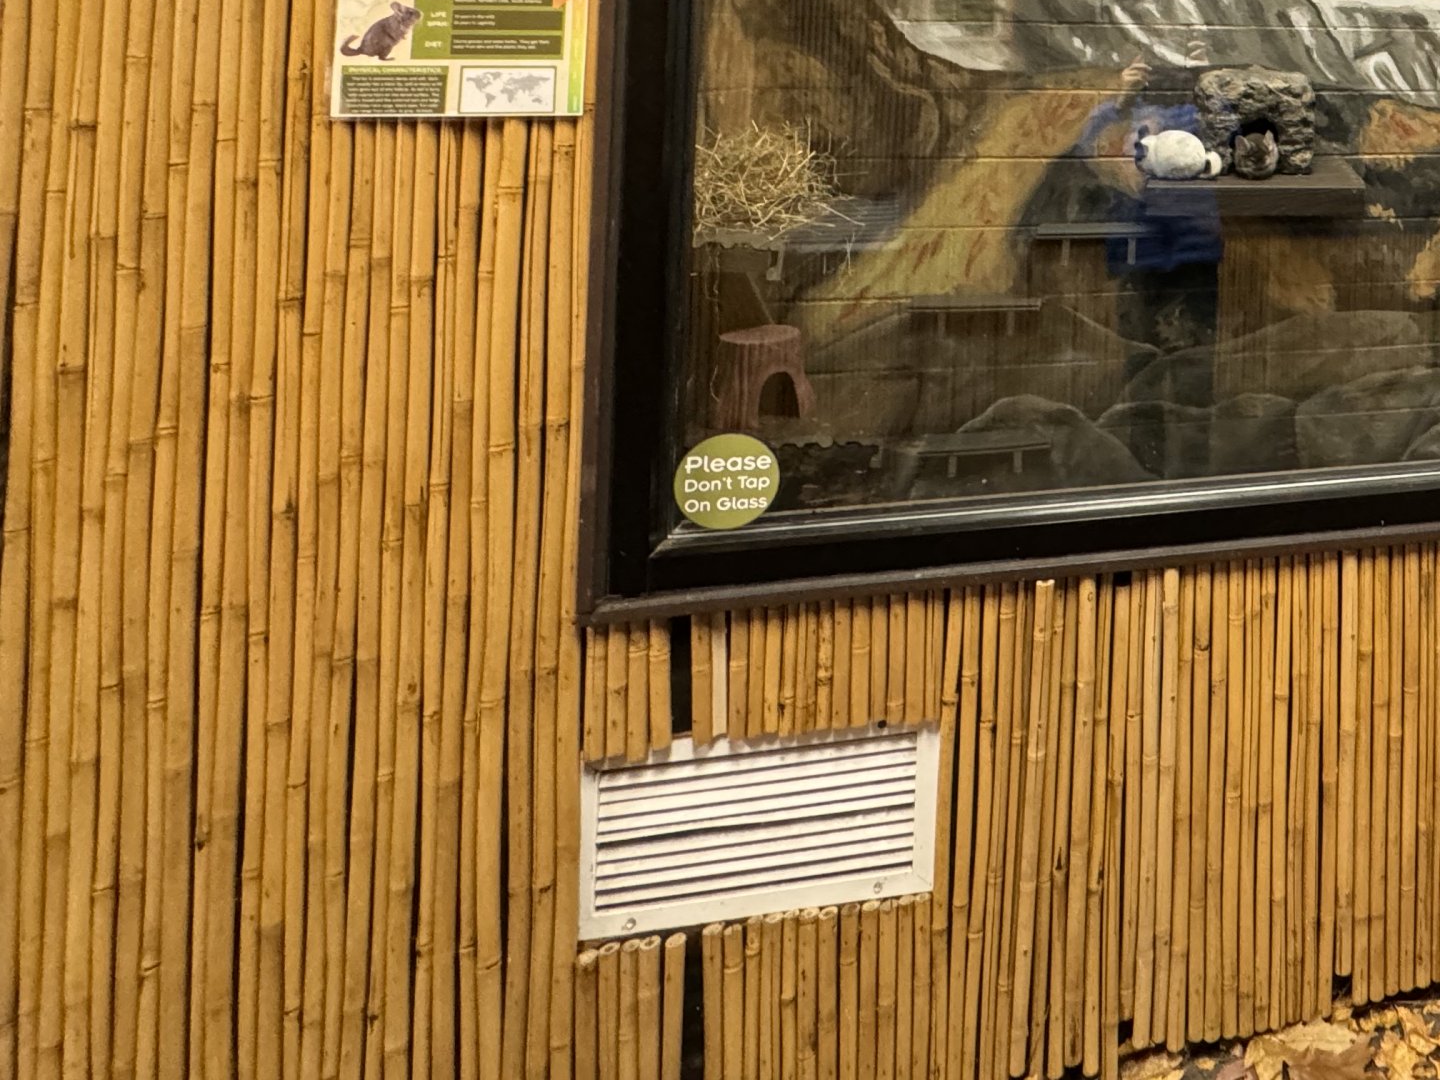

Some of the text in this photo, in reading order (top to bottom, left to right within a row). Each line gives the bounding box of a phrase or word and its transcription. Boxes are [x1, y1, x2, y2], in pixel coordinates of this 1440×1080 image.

[685, 454, 772, 474] Please
[685, 475, 770, 493] Don't Tap
[685, 496, 768, 513] On Glass
